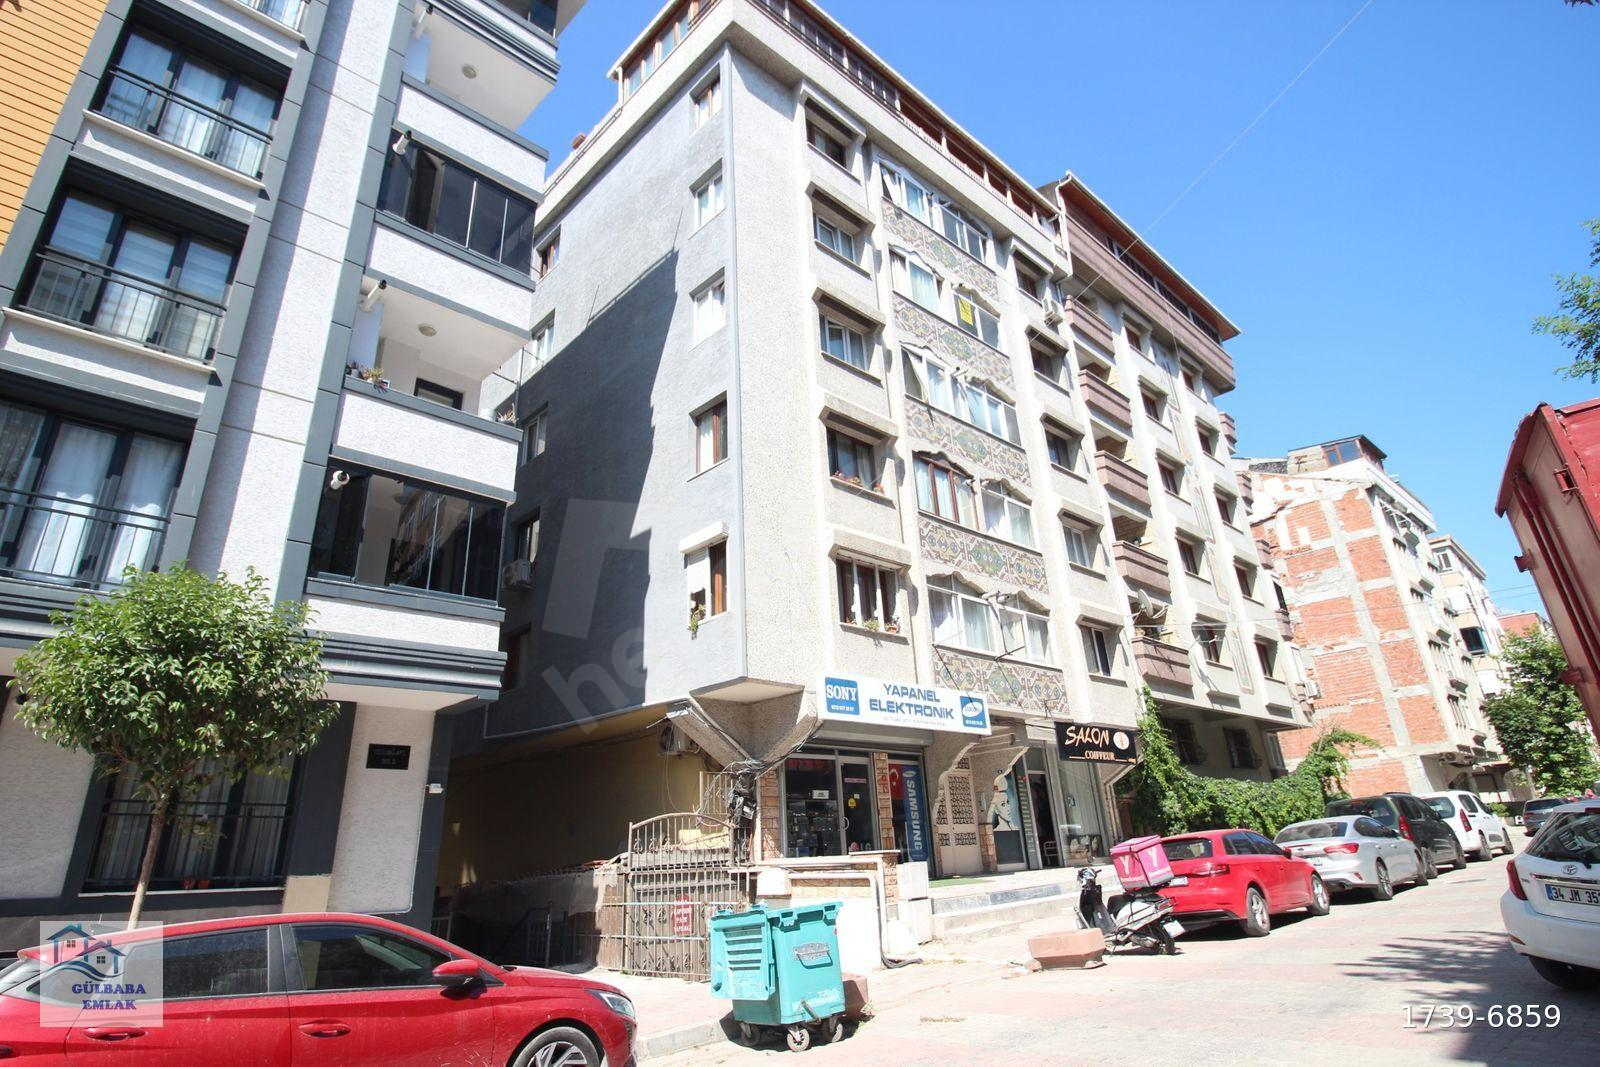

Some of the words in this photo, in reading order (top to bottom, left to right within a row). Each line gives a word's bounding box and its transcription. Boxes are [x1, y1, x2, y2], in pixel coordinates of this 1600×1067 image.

[826, 684, 857, 701] SONY
[883, 683, 941, 703] YAPANEL
[1064, 725, 1110, 748] SALON
[906, 779, 923, 850] SAMSUNG
[1552, 887, 1565, 900] 34
[1569, 889, 1581, 902] JM
